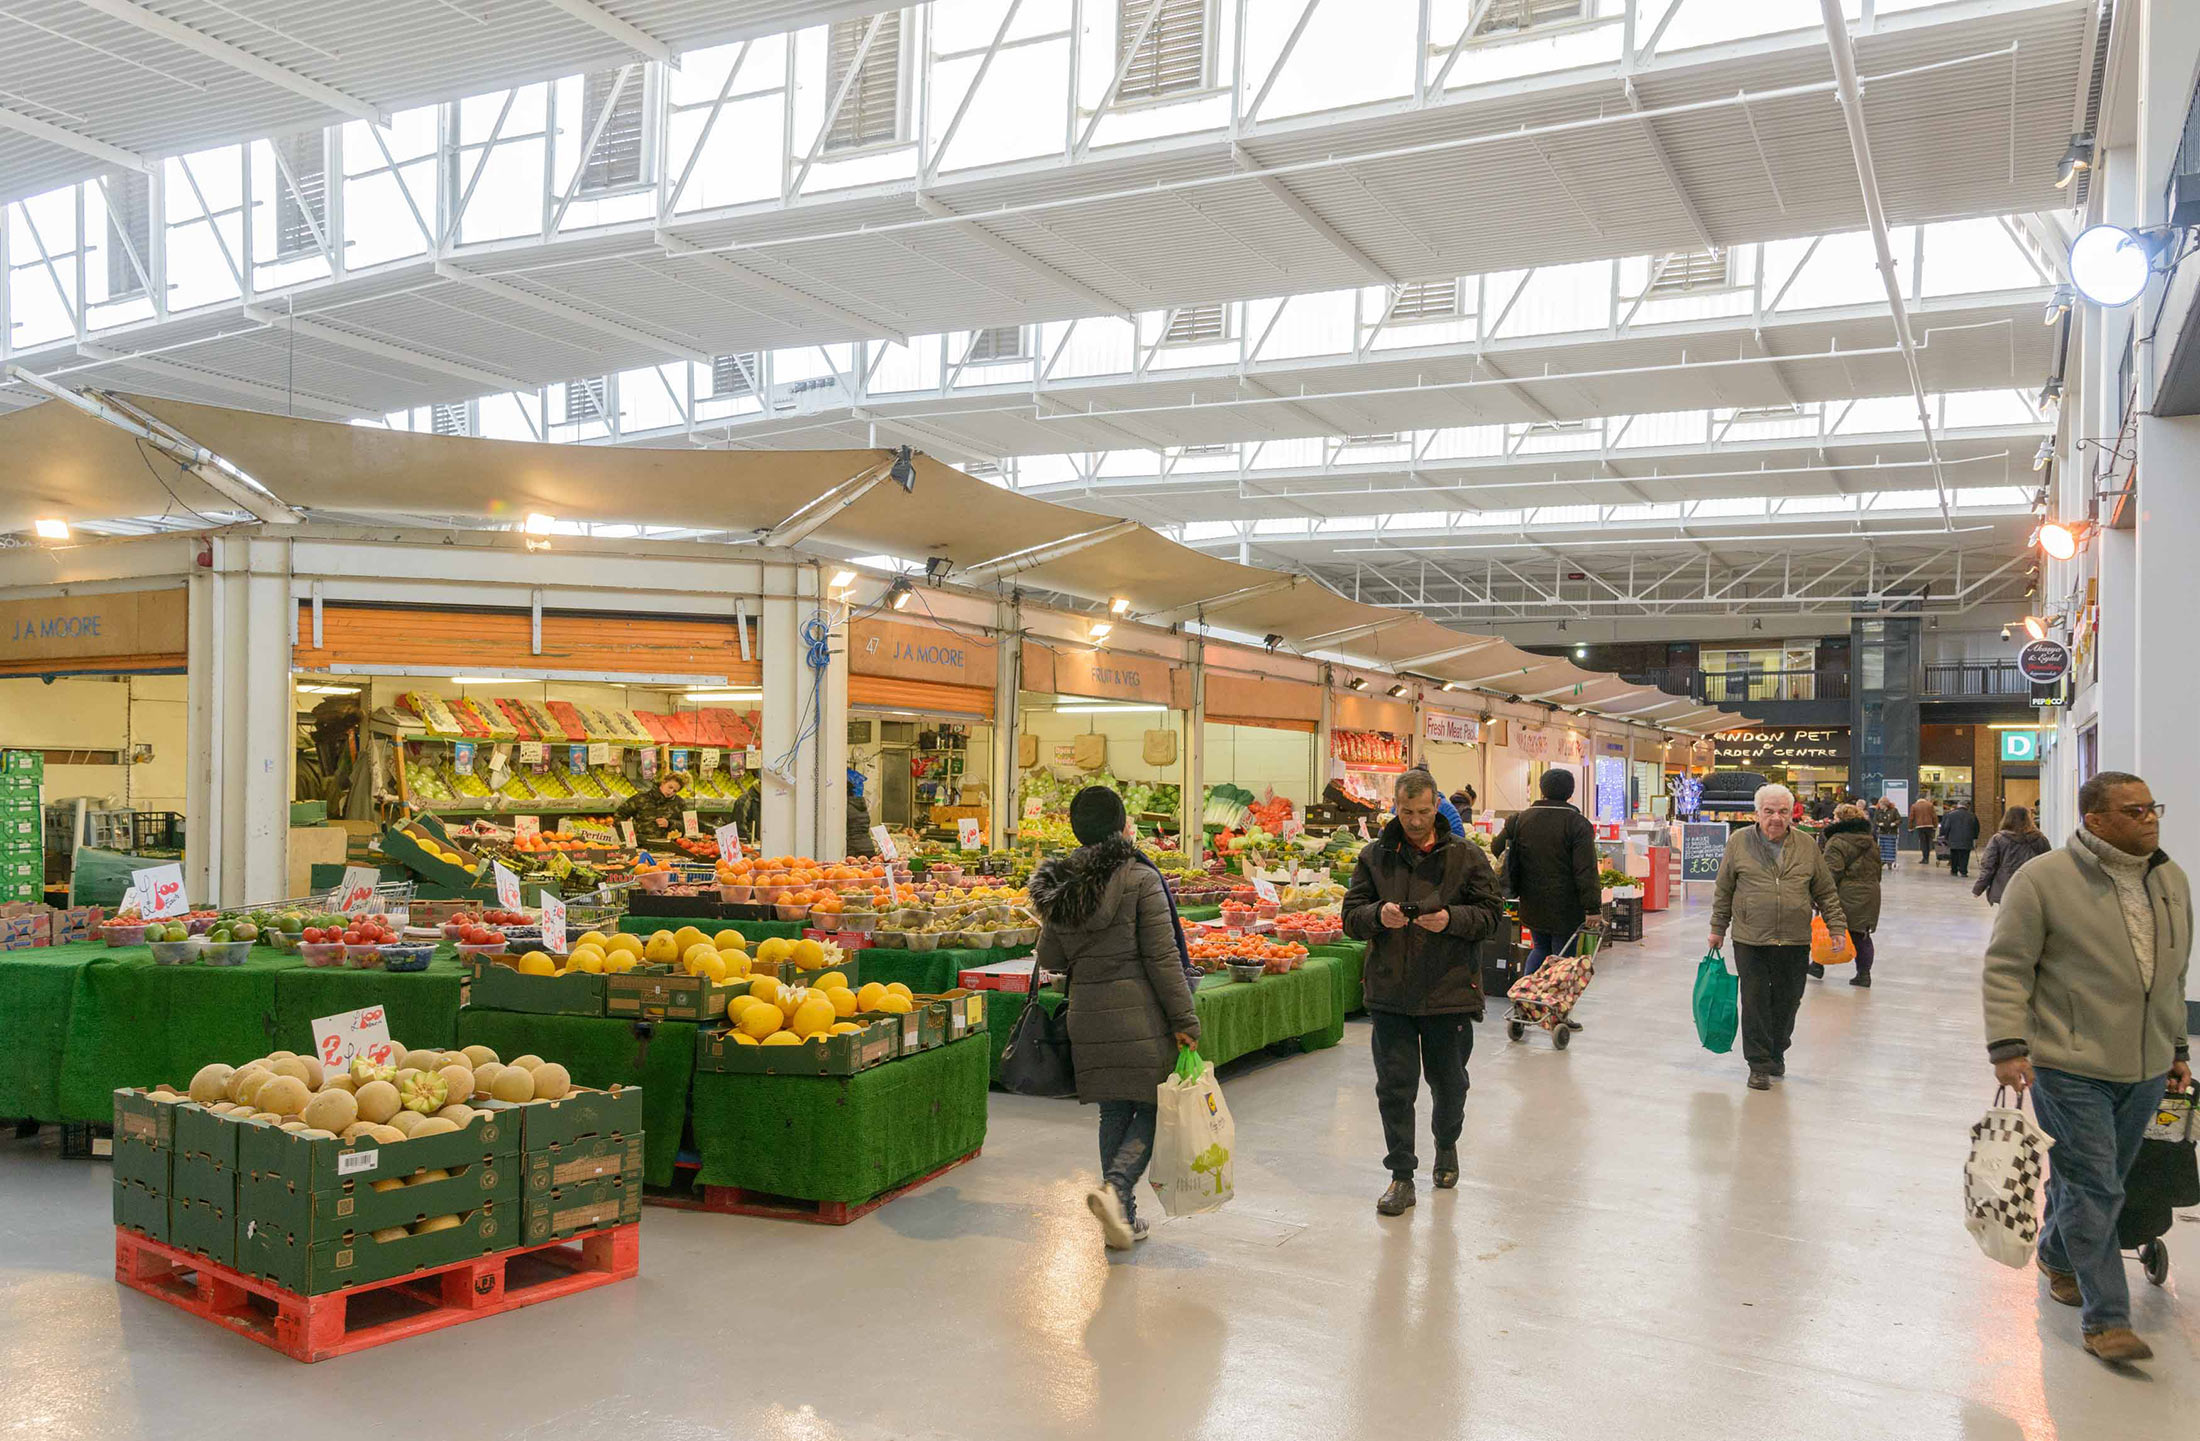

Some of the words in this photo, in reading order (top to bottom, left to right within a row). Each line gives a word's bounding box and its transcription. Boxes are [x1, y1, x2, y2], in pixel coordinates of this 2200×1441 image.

[13, 620, 20, 640] J
[24, 621, 36, 640] A
[40, 615, 101, 638] MOORE
[865, 637, 880, 655] 47
[893, 641, 900, 658] J
[903, 643, 914, 661] A
[916, 643, 963, 667] MOORE
[1091, 667, 1113, 684] FRUIT
[1114, 670, 1121, 684] &
[1121, 671, 1141, 687] VEG
[1427, 717, 1445, 737] Fresh
[1447, 720, 1463, 739] Meat
[1793, 730, 1838, 742] PET
[1773, 748, 1837, 757] CENTRE
[2007, 735, 2031, 756] D
[581, 829, 612, 842] Perlim
[1690, 858, 1719, 874] £30
[321, 1034, 343, 1068] 2
